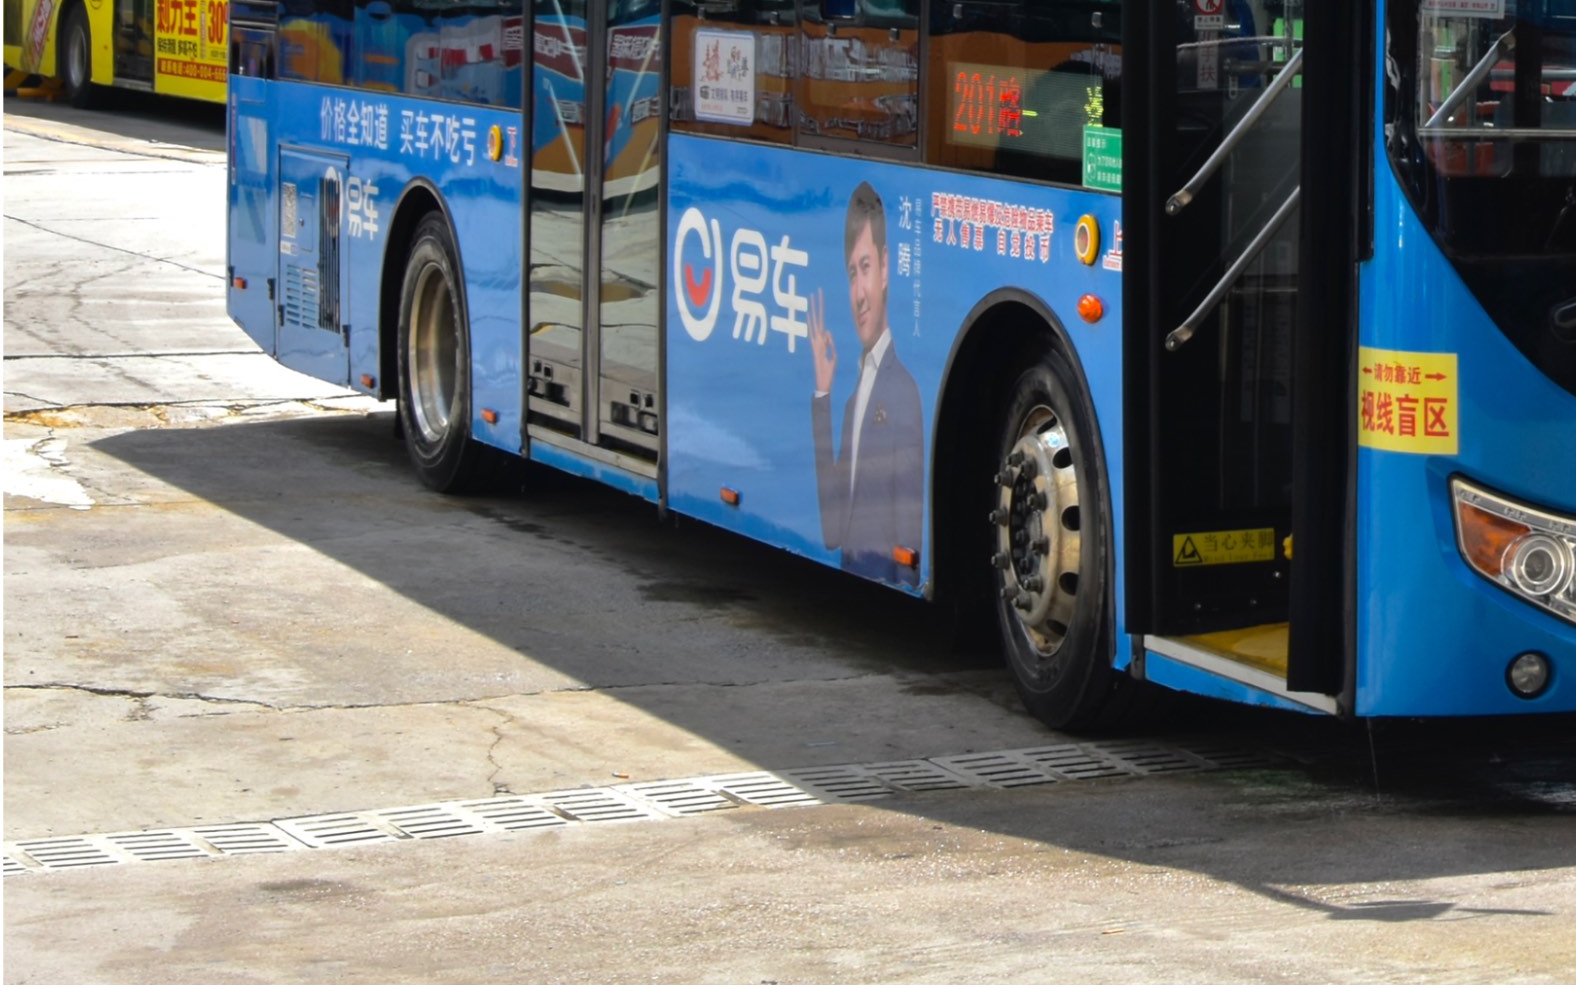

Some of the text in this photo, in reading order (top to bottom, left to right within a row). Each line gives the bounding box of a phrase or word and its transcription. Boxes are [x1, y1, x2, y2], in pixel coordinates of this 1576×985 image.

[320, 96, 476, 166] 价格全知道 买车不吃亏
[346, 175, 379, 241] 易车
[730, 228, 808, 354] 易车
[1373, 363, 1422, 385] 请勿靠近
[1361, 390, 1450, 437] 视线盲区
